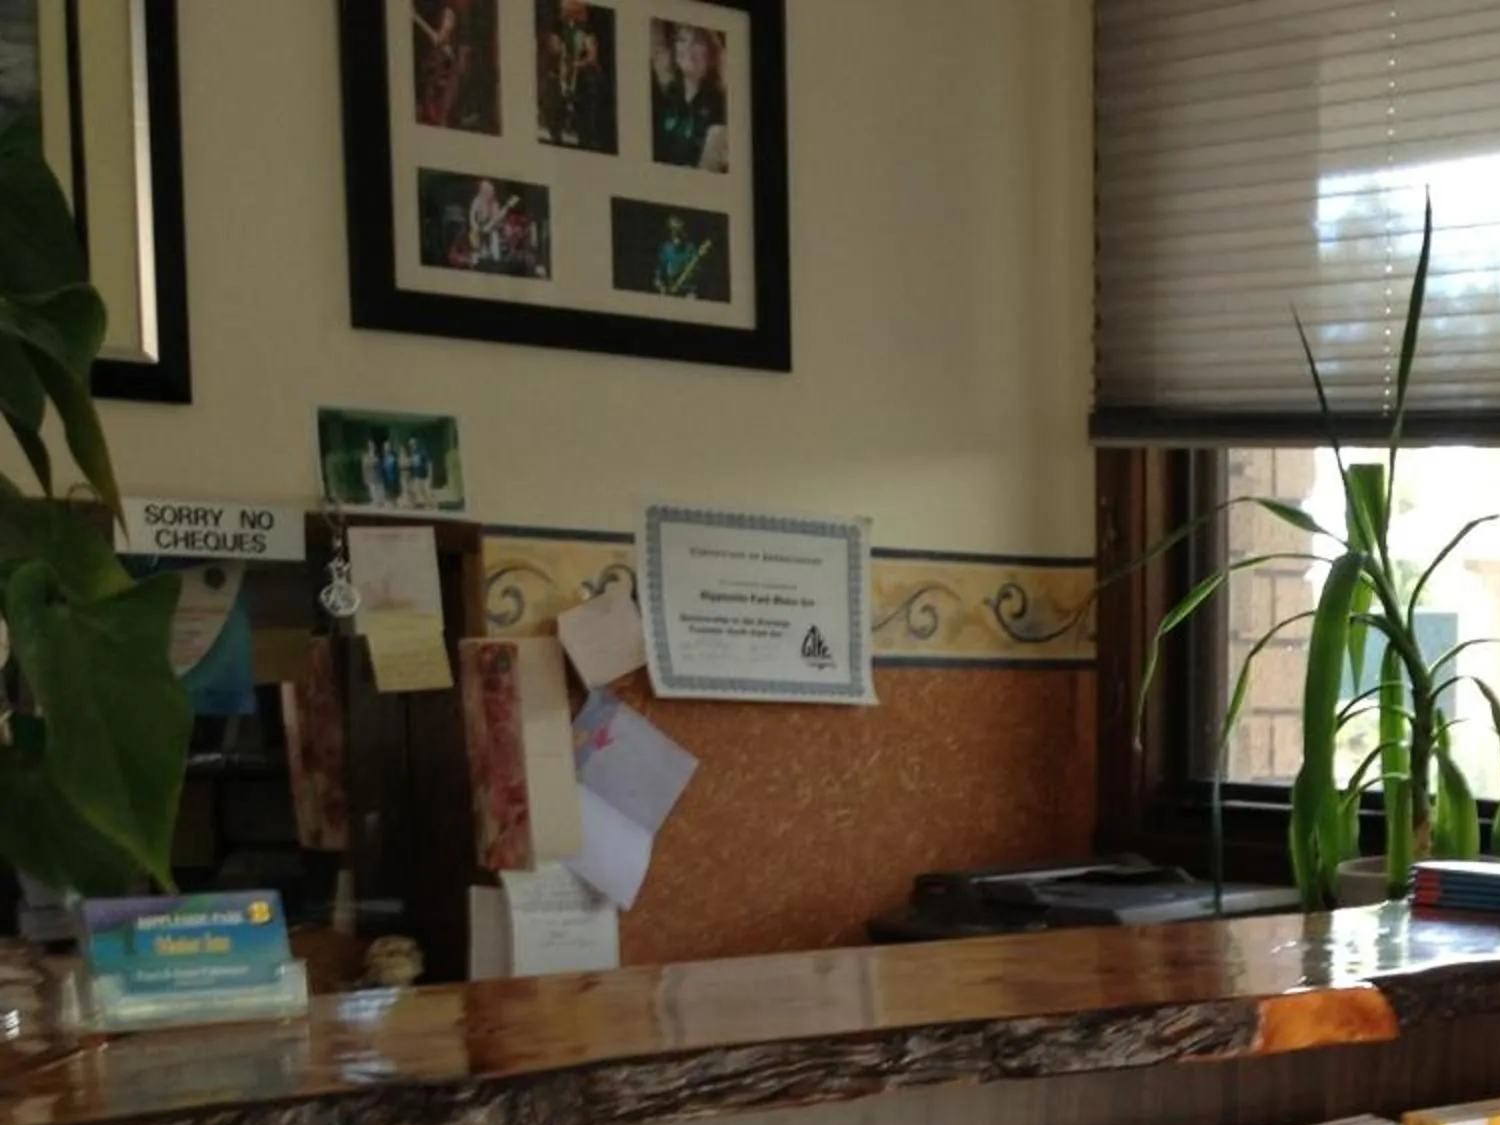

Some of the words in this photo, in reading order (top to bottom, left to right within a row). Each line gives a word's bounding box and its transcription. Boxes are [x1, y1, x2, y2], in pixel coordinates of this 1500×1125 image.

[144, 503, 224, 528] SORRY
[240, 509, 275, 531] NO
[154, 528, 267, 554] CHEQUES
